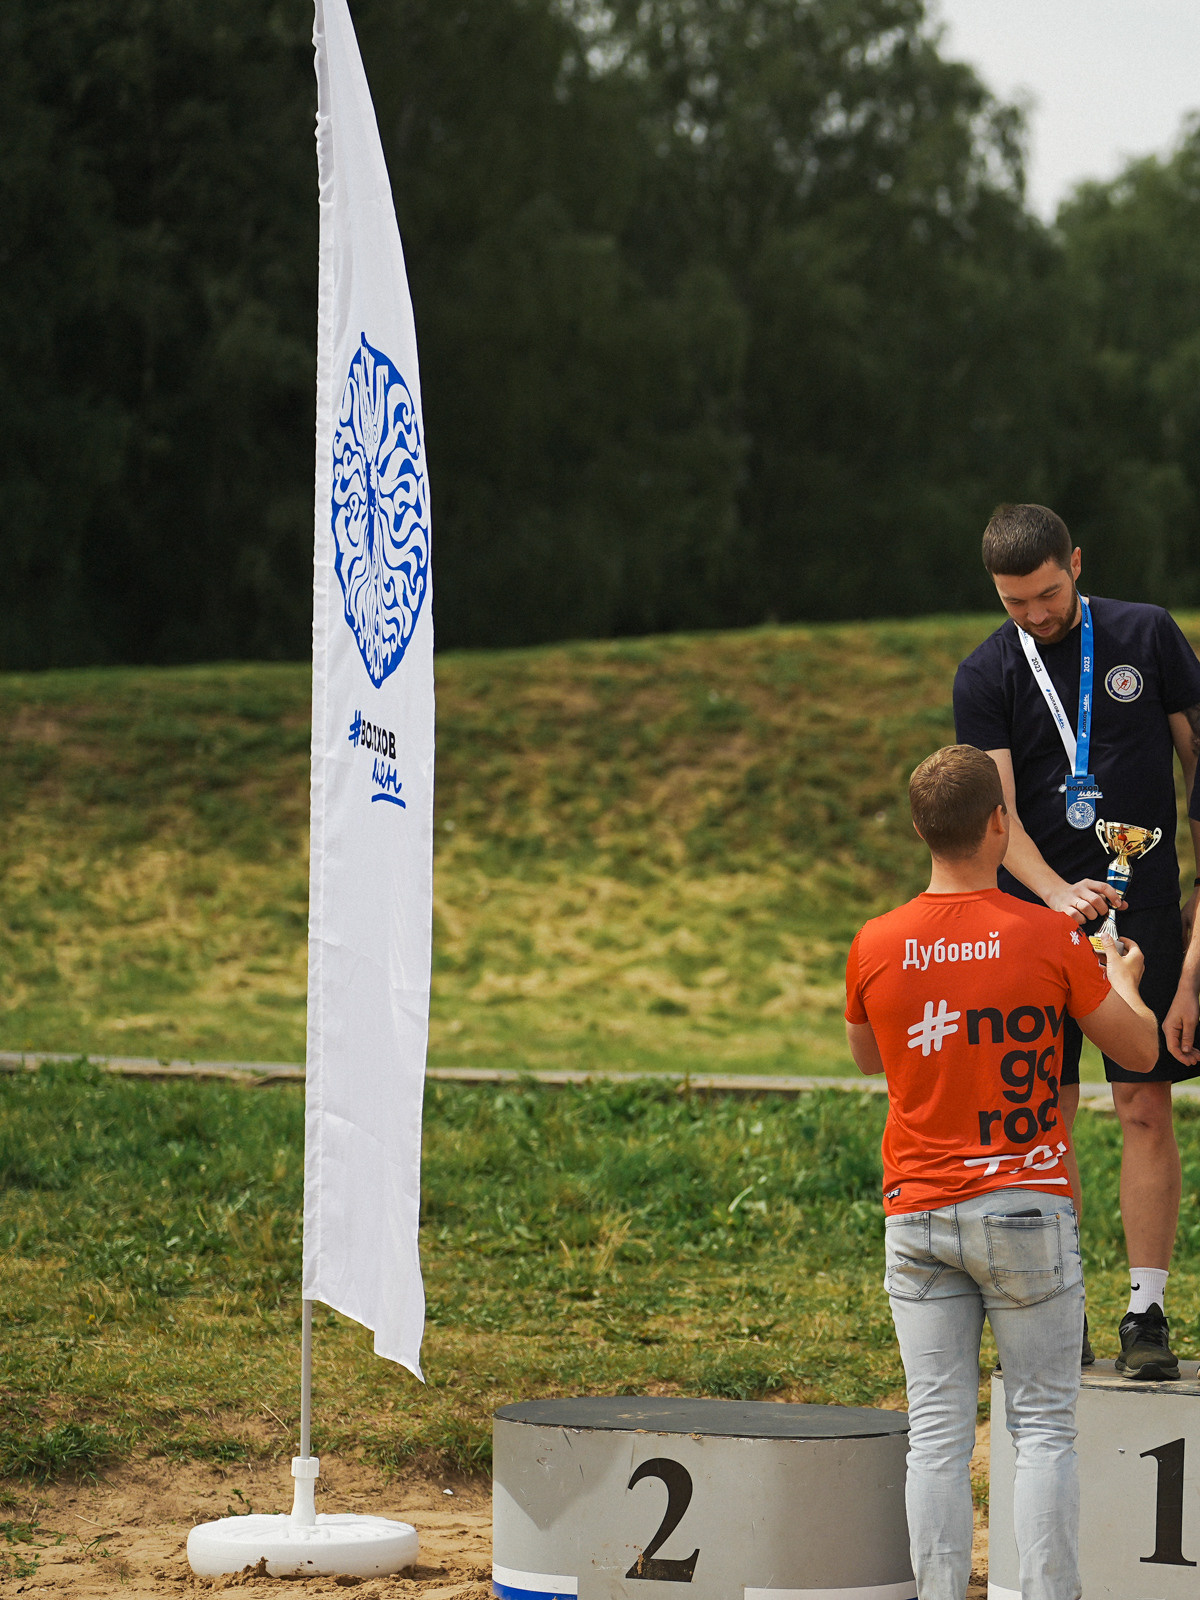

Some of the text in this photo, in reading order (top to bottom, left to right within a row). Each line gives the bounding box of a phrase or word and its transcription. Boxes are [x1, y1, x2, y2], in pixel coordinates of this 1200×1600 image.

[348, 709, 396, 760] #ВОЛХОВ
[902, 931, 1000, 971] Дубовой
[907, 999, 1067, 1057] #nov
[625, 1458, 700, 1583] 2
[1140, 1438, 1197, 1567] 1
